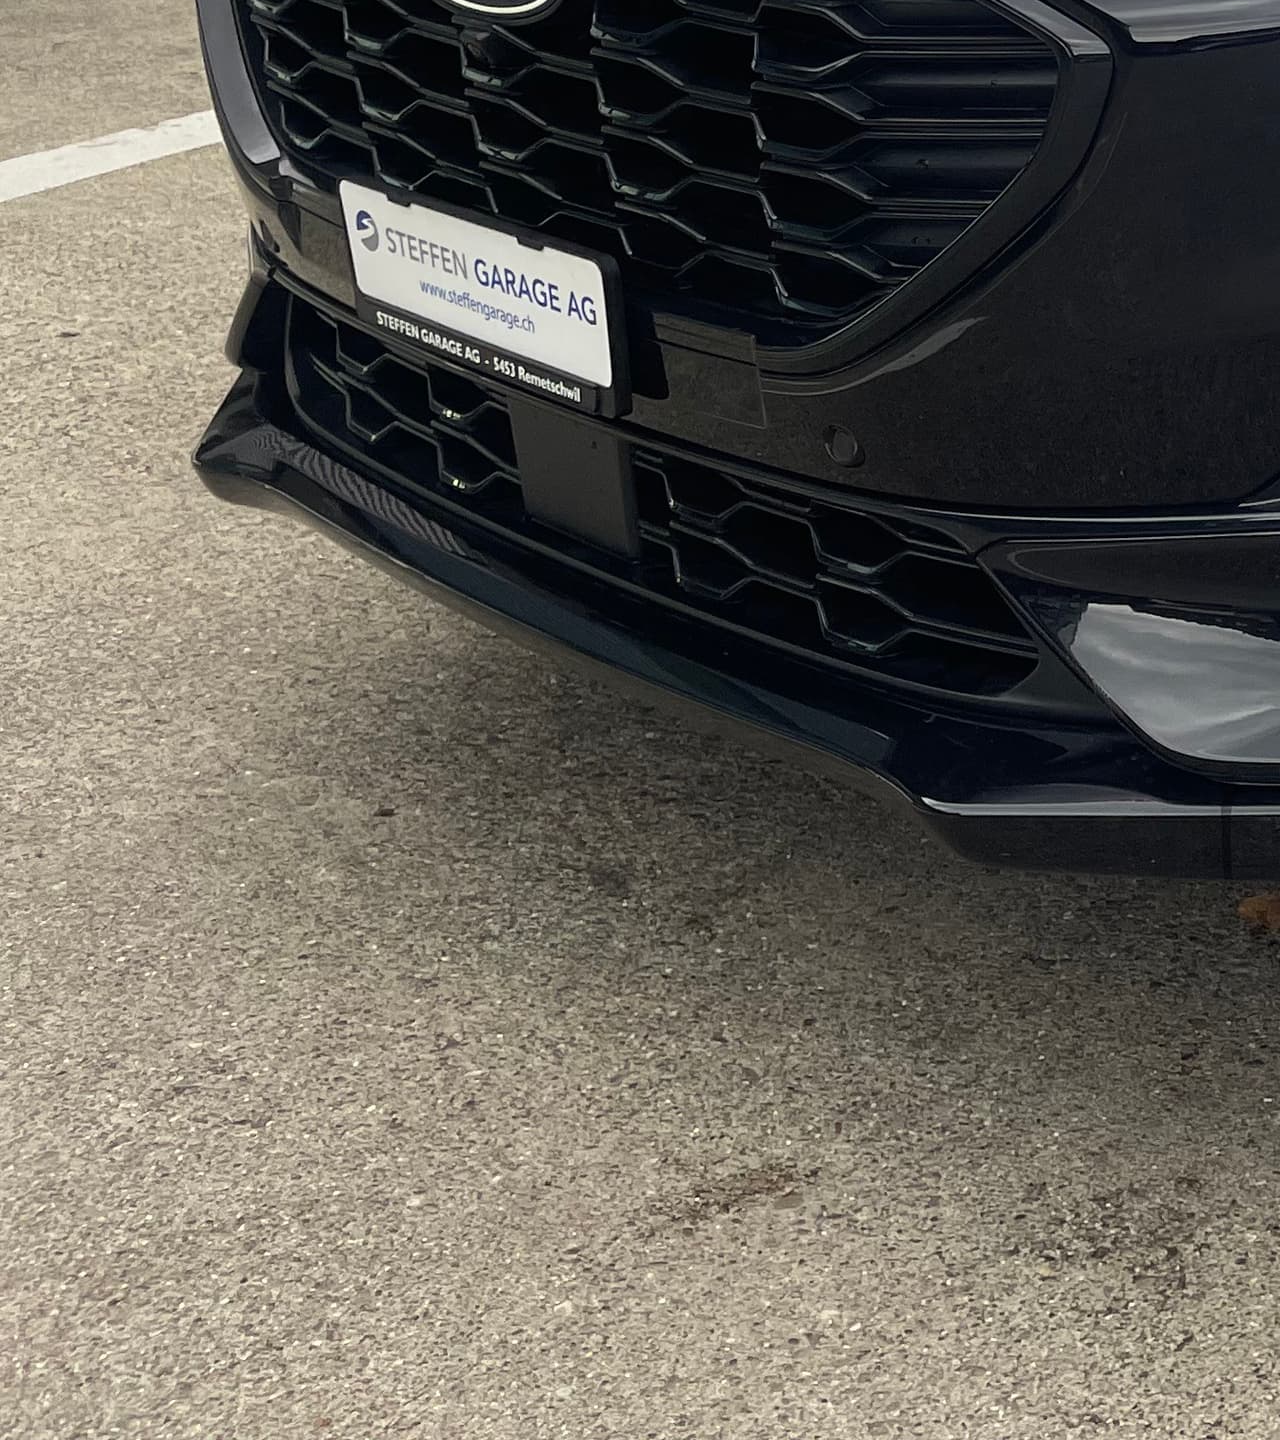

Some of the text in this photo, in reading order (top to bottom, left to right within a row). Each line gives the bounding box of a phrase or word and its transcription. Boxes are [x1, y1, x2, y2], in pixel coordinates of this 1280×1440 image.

[385, 228, 597, 325] STEFFEN GARAGE AG
[420, 280, 535, 333] www.steffengarage.ch
[376, 311, 419, 339] STEFFEN
[420, 328, 463, 357] GARAGE
[465, 346, 480, 363] AG
[493, 356, 515, 378] 5453
[518, 366, 581, 402] Remetschwil
